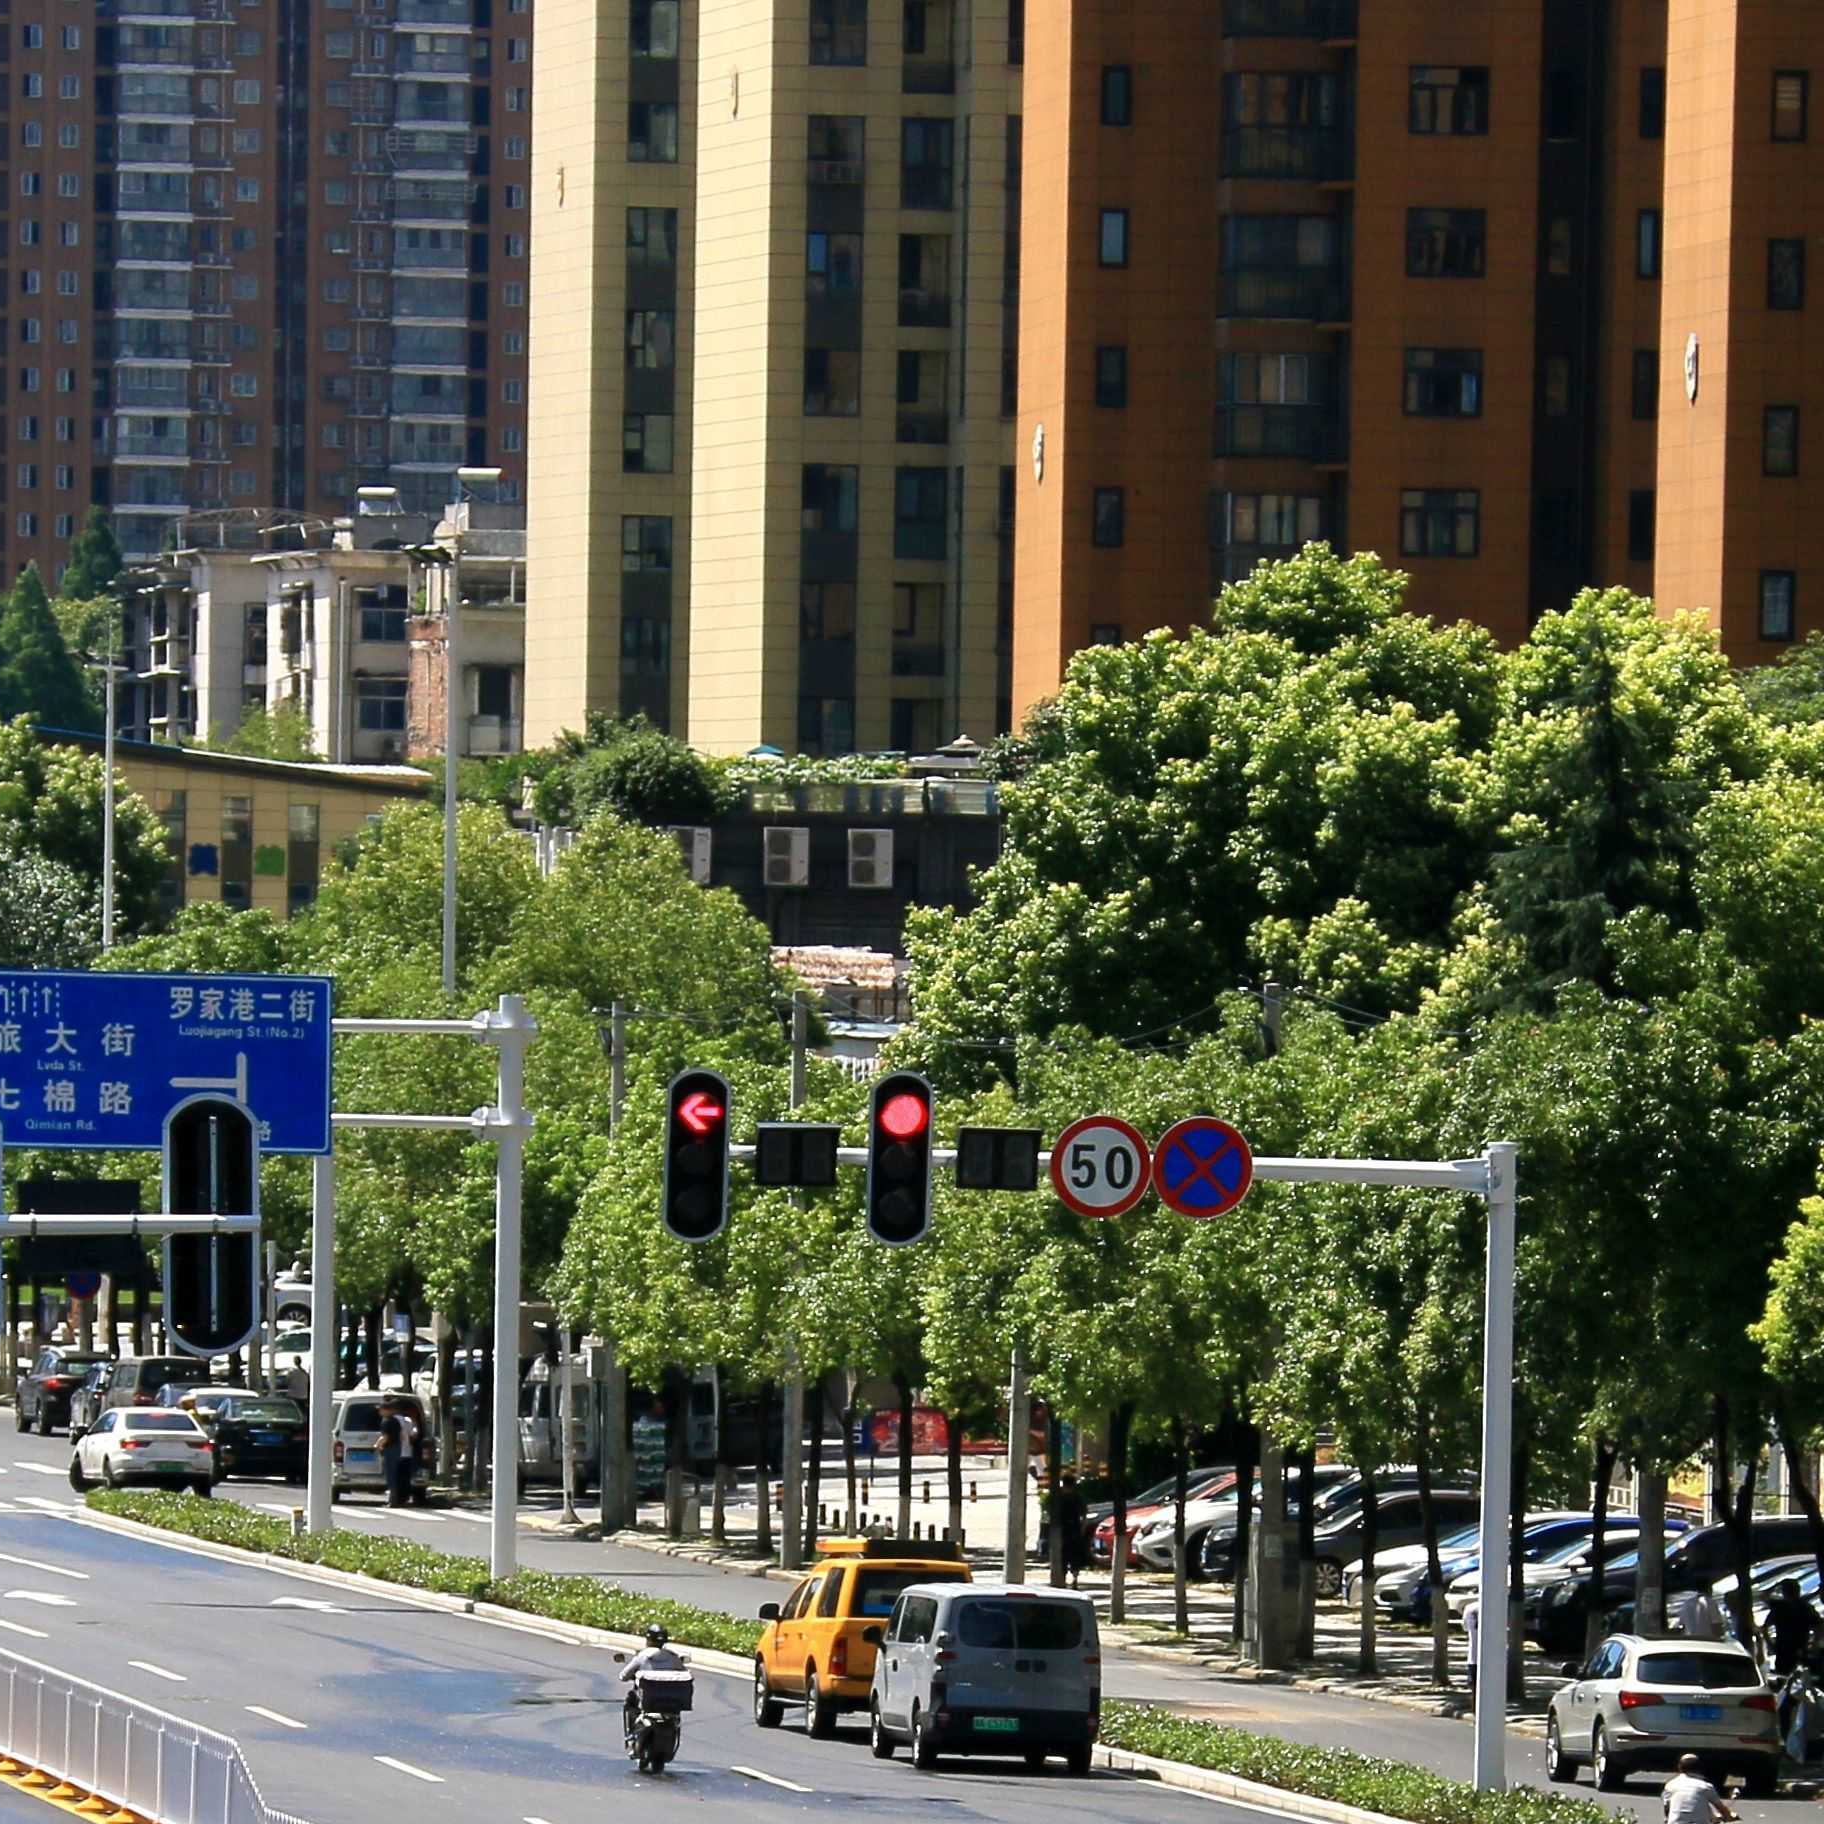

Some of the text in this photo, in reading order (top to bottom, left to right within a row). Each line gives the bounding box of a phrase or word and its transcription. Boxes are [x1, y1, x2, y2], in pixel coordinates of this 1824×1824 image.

[170, 986, 315, 1022] 罗家港二街
[179, 1024, 242, 1039] Luojiagang
[68, 1060, 85, 1071] St.
[25, 1119, 96, 1131] Qimian Rd.
[1071, 1144, 1133, 1189] 50
